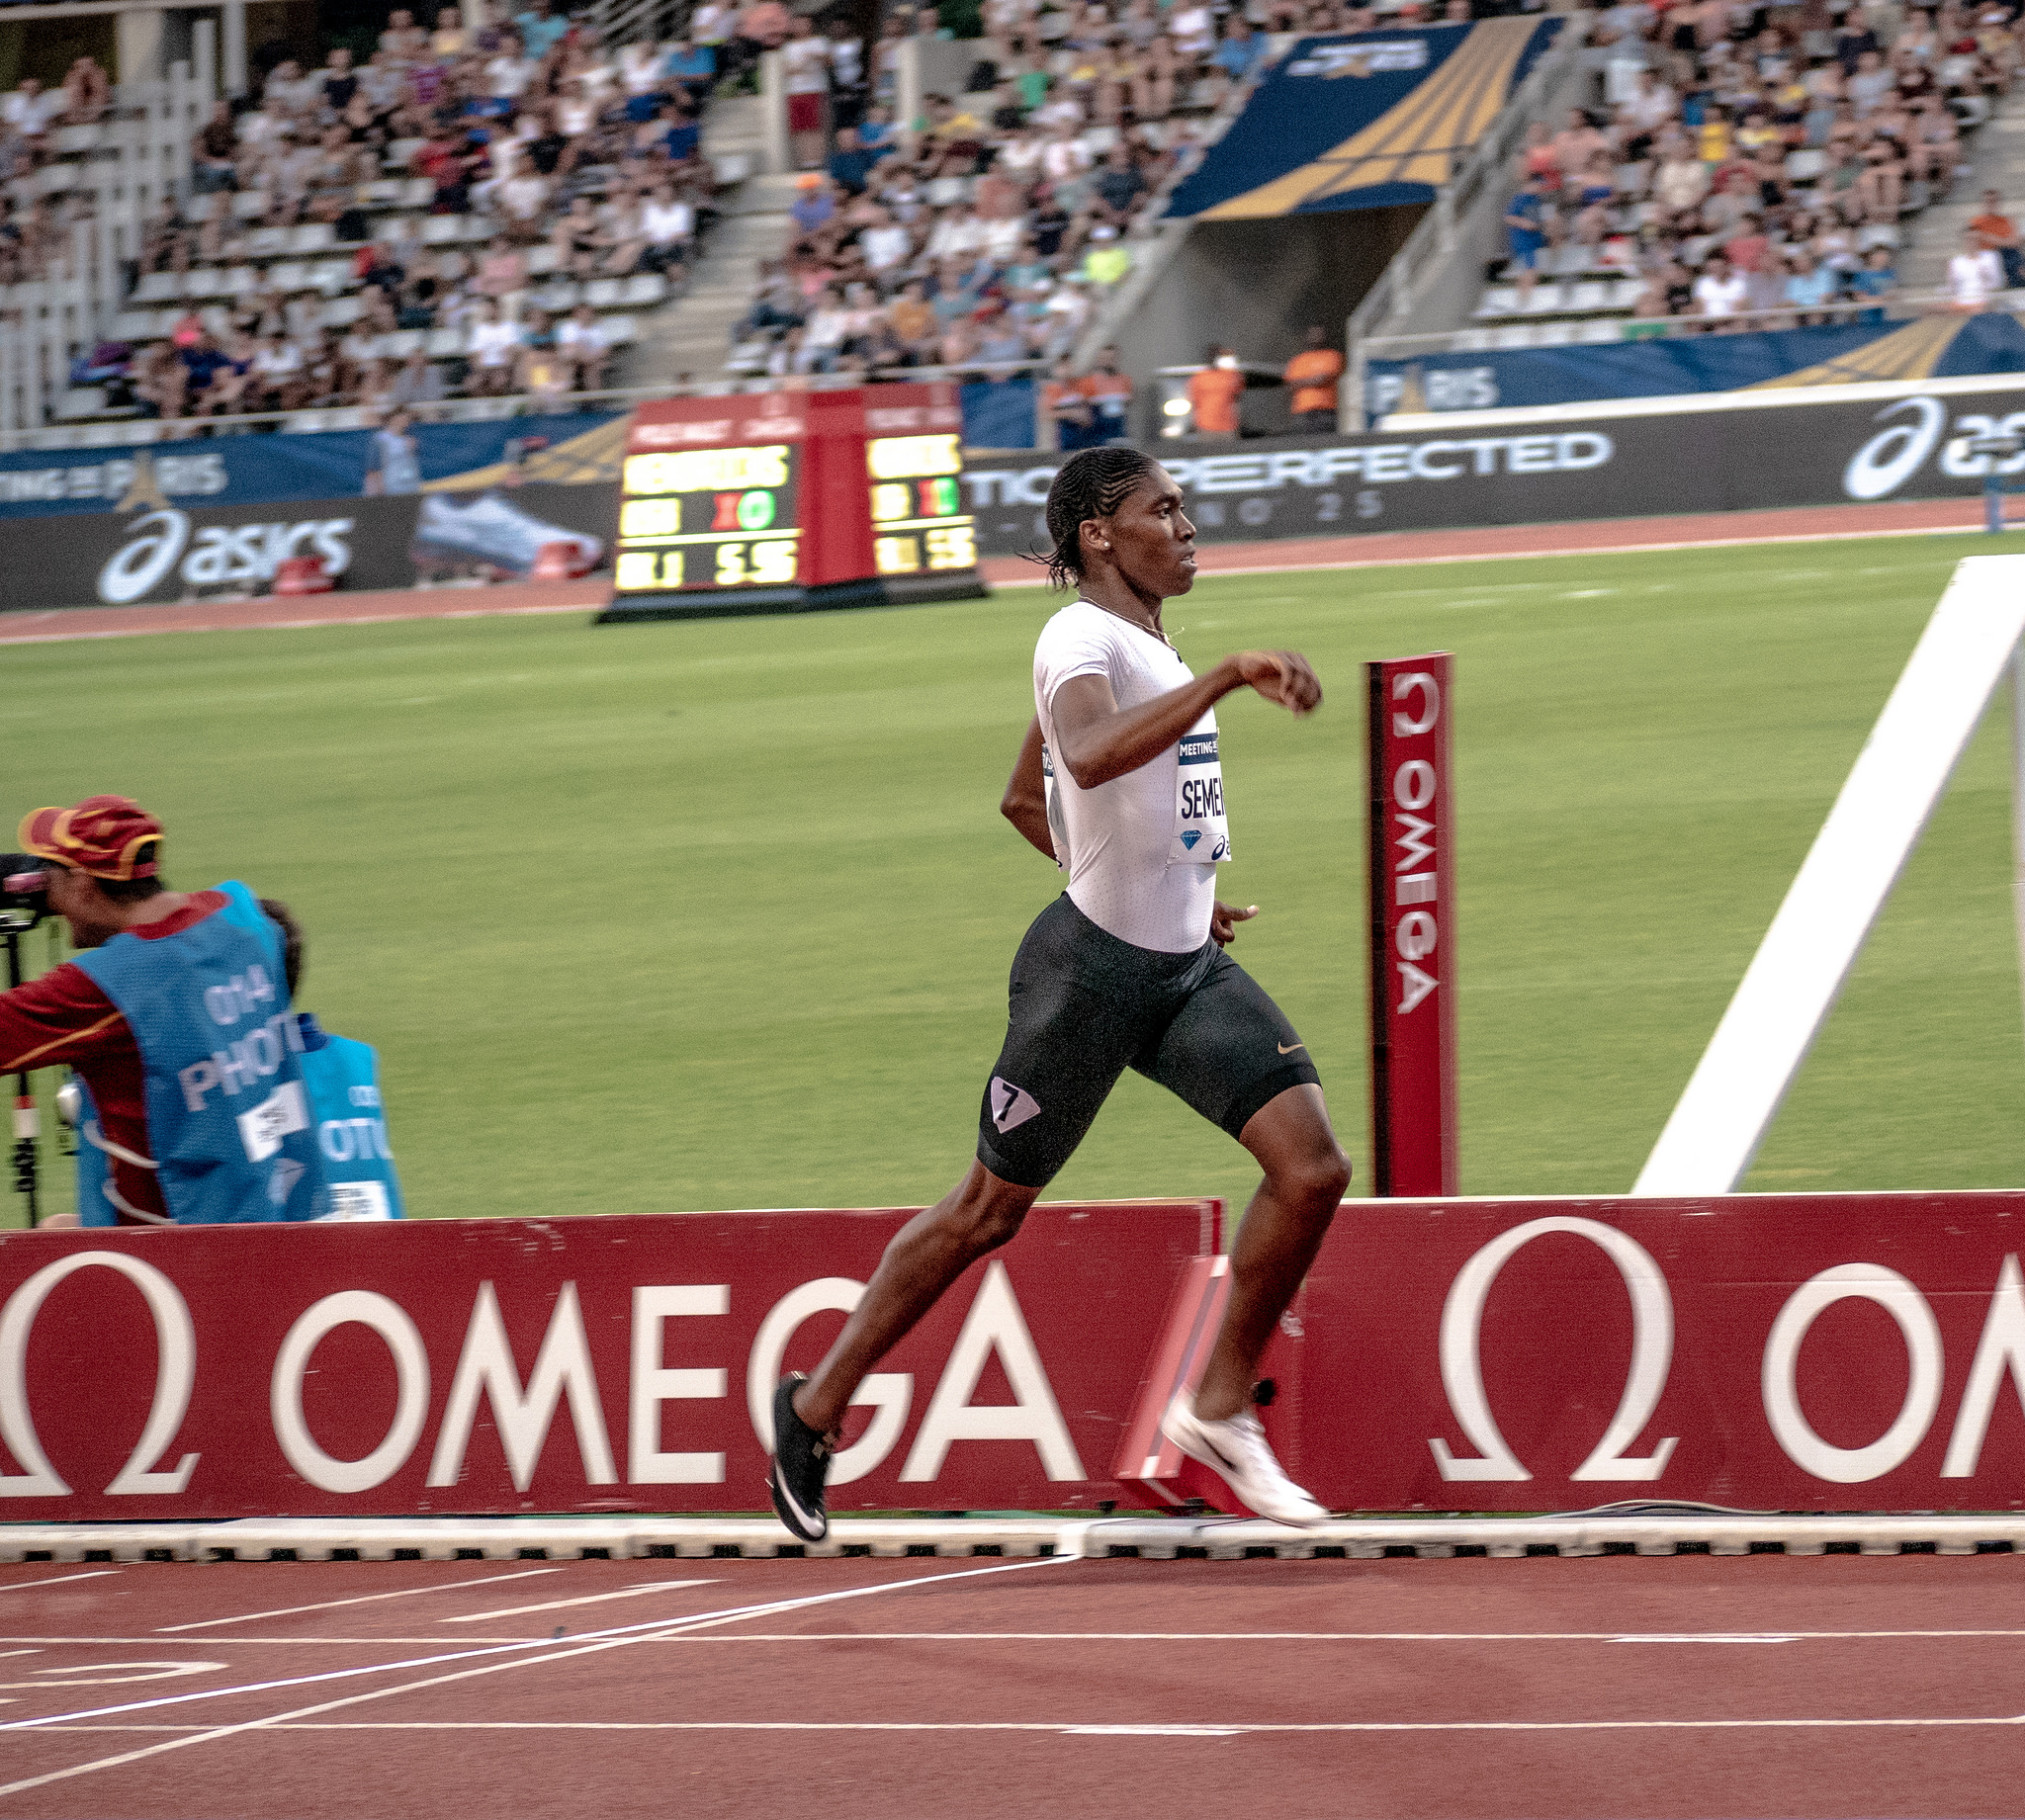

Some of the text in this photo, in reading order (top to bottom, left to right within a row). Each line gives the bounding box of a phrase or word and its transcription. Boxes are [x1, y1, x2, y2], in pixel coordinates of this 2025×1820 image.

[1158, 432, 1614, 494] PERFECTED
[1180, 740, 1213, 757] MEETING
[1392, 759, 1441, 1015] OMEGA
[998, 1082, 1019, 1123] 7
[271, 1260, 1087, 1493] OMEGA
